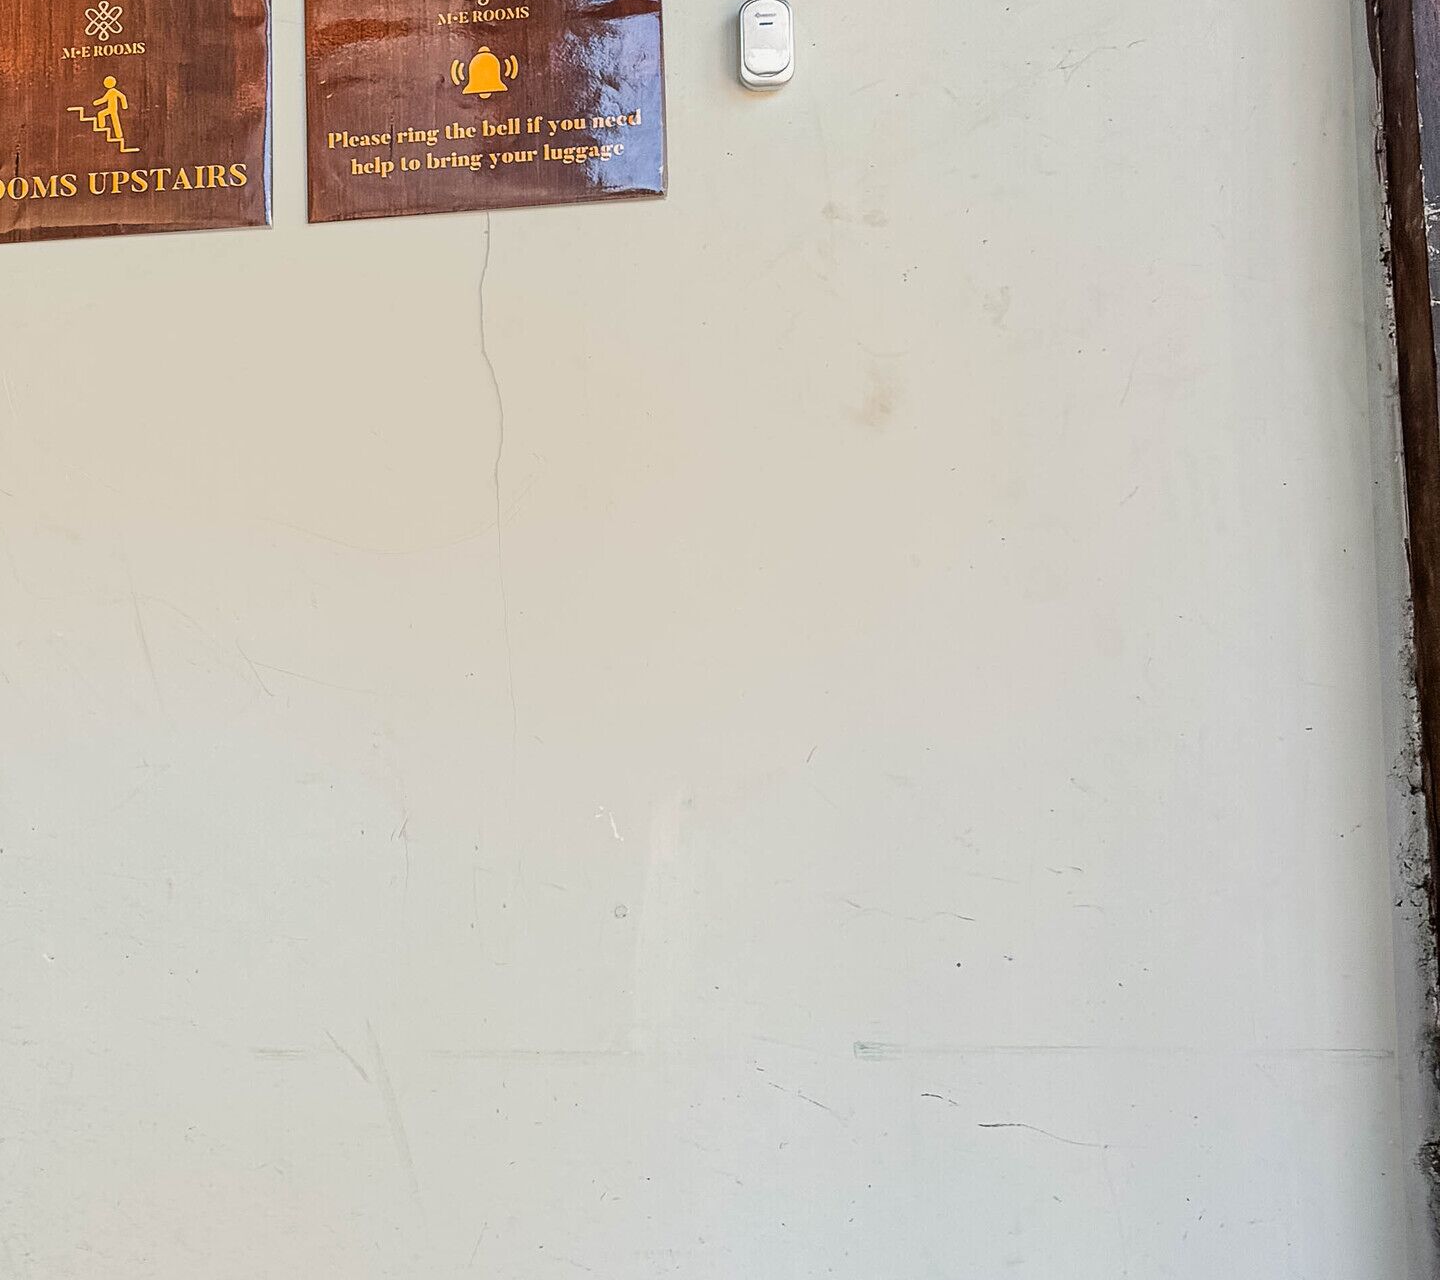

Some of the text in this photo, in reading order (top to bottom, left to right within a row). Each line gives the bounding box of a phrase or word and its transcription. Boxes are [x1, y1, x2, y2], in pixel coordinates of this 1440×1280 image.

[472, 6, 530, 24] ROOMS
[93, 41, 146, 58] ROOMS
[327, 108, 642, 150] Please ring the bell if you need
[350, 142, 625, 179] help to bring your luggage
[88, 162, 248, 196] UPSTAIRS
